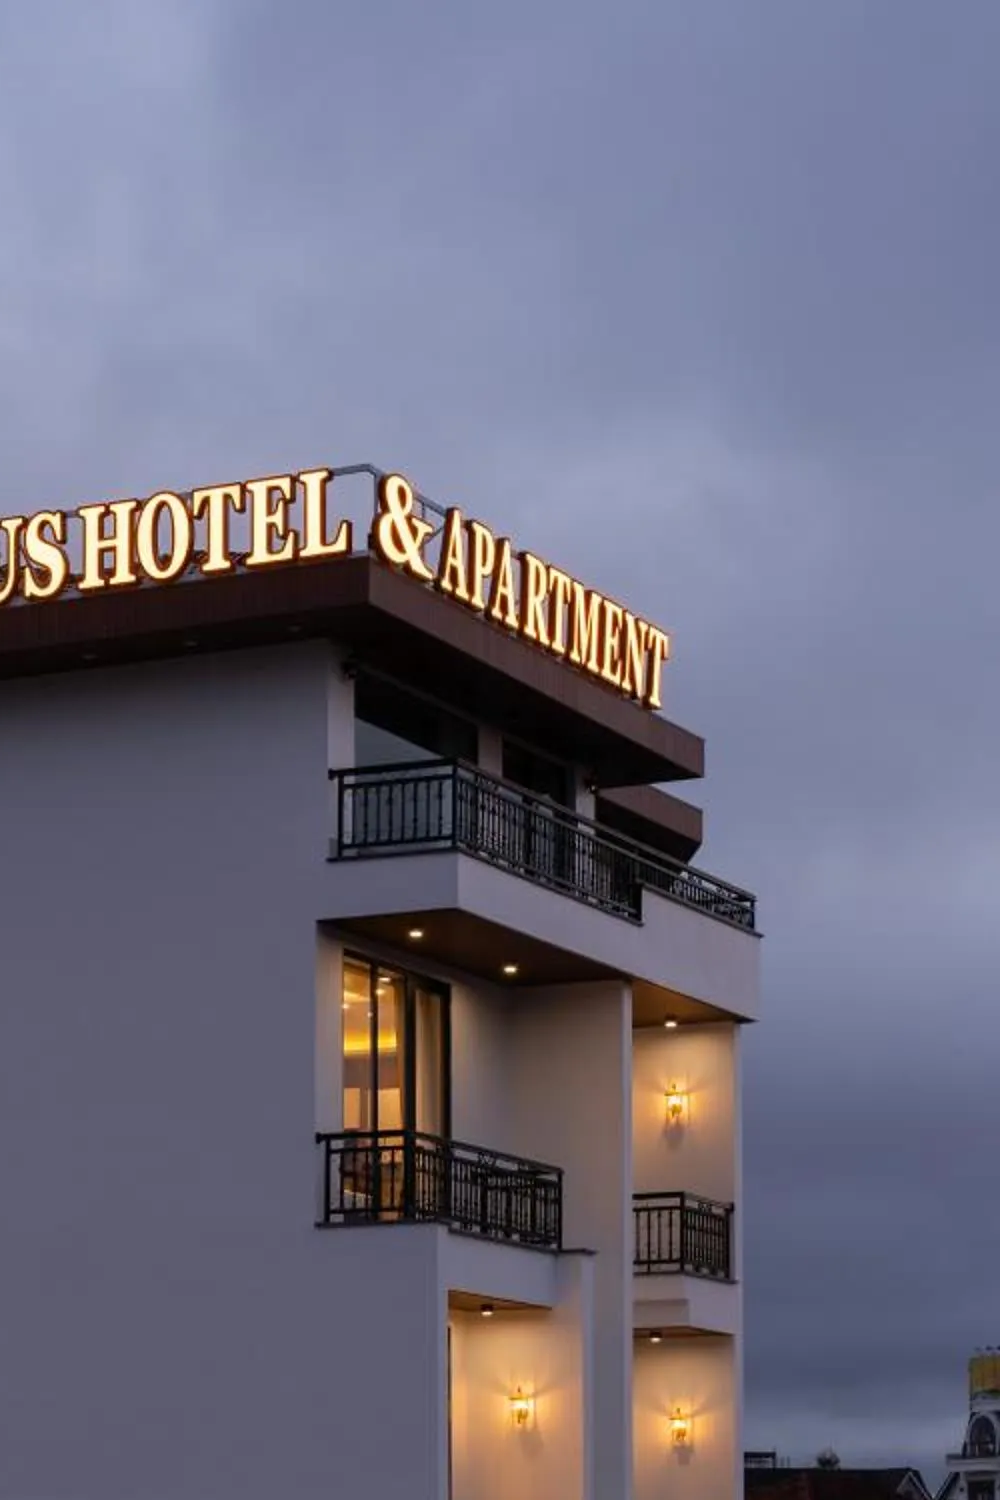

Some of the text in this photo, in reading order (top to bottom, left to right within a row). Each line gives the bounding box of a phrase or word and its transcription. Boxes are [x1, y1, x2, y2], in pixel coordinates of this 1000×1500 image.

[77, 467, 352, 592] HOTEL
[376, 473, 433, 581] &
[439, 507, 671, 709] APARTMENT
